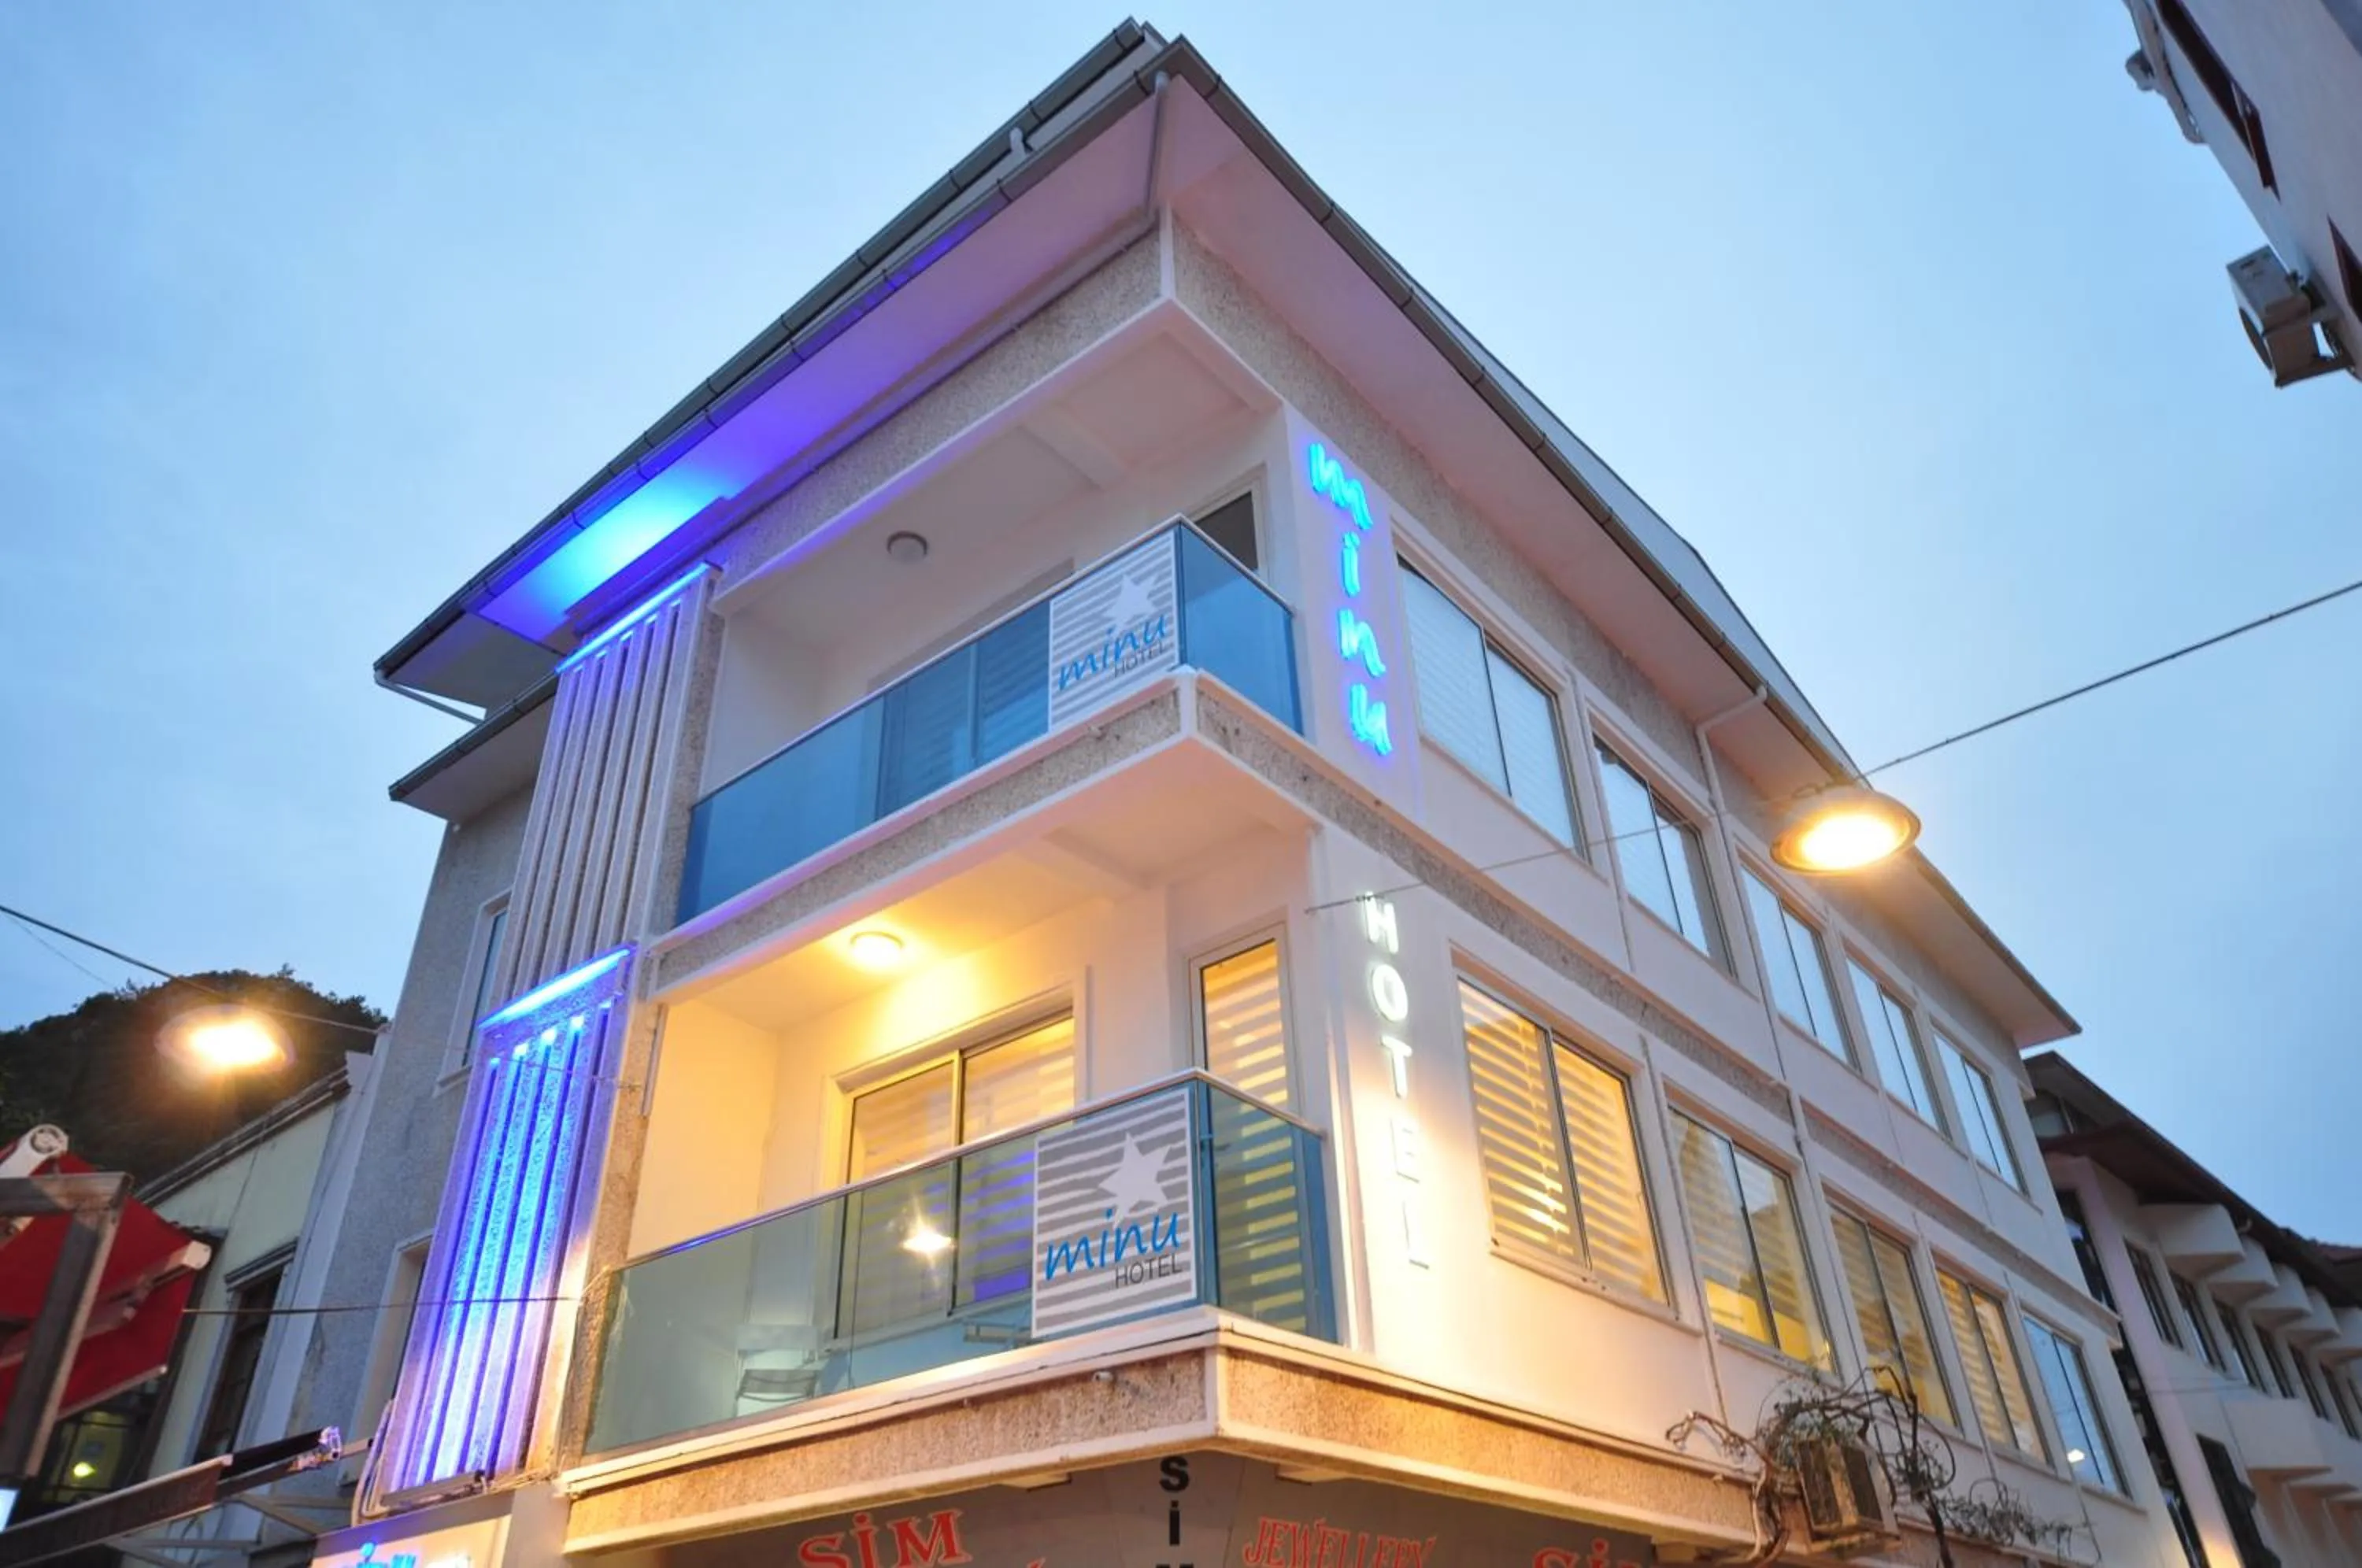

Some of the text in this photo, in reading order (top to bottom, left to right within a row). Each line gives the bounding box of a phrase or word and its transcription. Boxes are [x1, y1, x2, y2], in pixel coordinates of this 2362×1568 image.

[1309, 442, 1392, 756] minu
[1058, 615, 1167, 691] minu
[1113, 641, 1165, 679] HOTEL
[1364, 890, 1430, 1270] HOTEL
[1046, 1206, 1179, 1281] minu
[1115, 1254, 1182, 1289] HOTEL
[1155, 1455, 1194, 1568] Sİ
